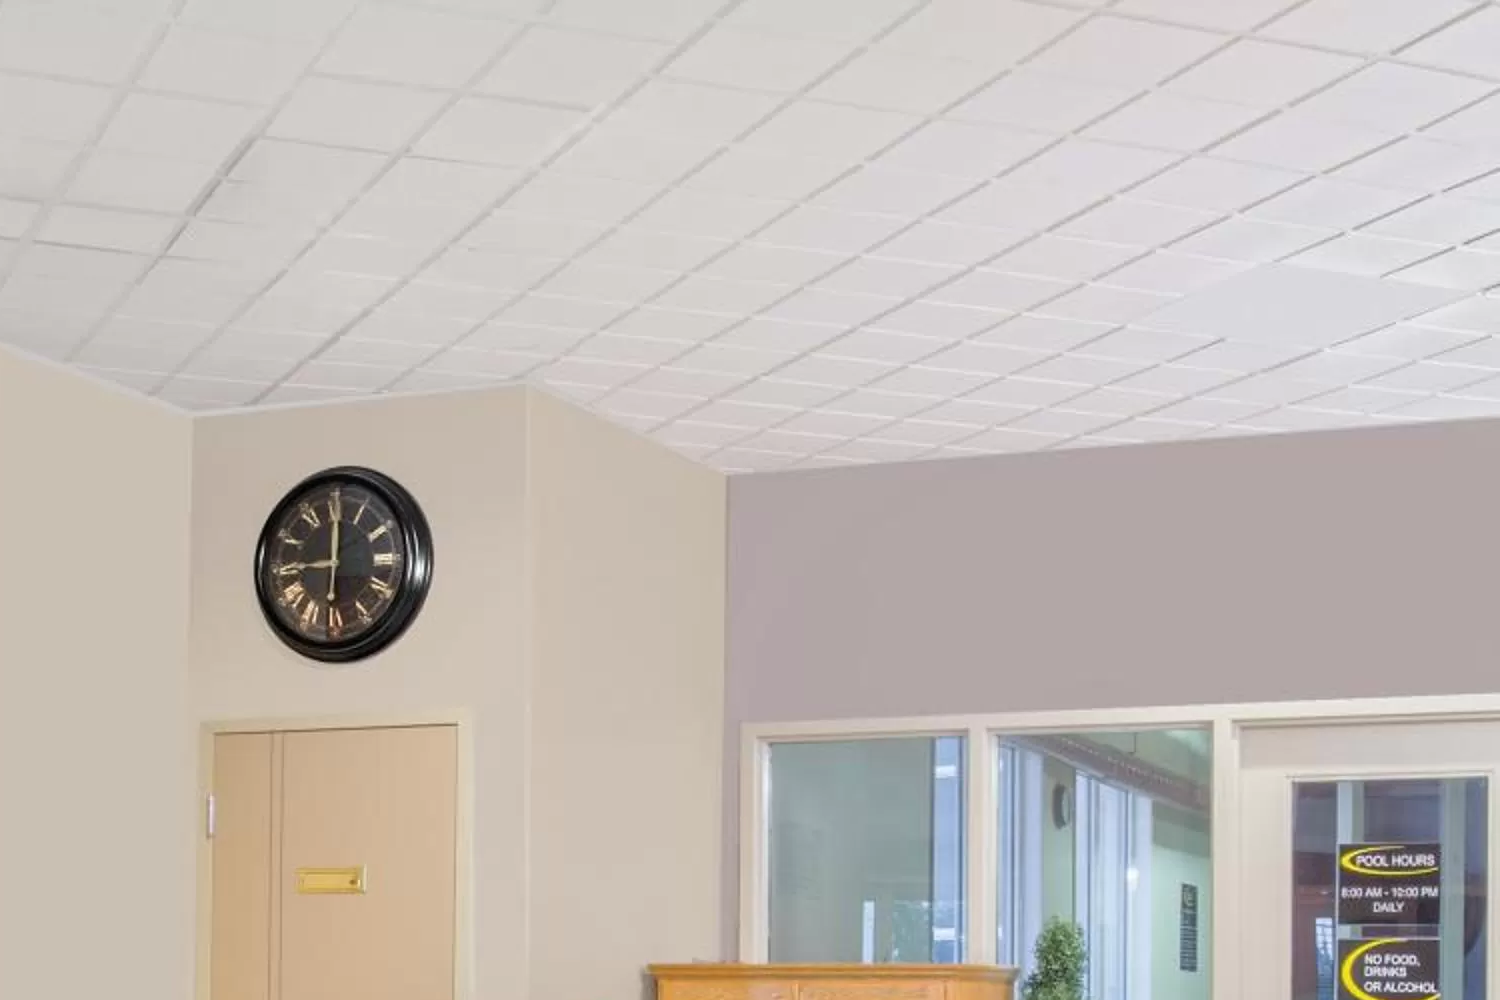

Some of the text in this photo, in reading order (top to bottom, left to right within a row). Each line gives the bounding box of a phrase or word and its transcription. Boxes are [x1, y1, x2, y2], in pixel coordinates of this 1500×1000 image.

[1356, 853, 1436, 868] POOL HOURS
[1365, 886, 1382, 898] AM
[1421, 885, 1440, 897] PM
[1373, 901, 1405, 913] DAILY
[1364, 953, 1382, 965] NO
[1364, 966, 1407, 977] DRINKS
[1363, 981, 1438, 993] OR ALCOHOL
